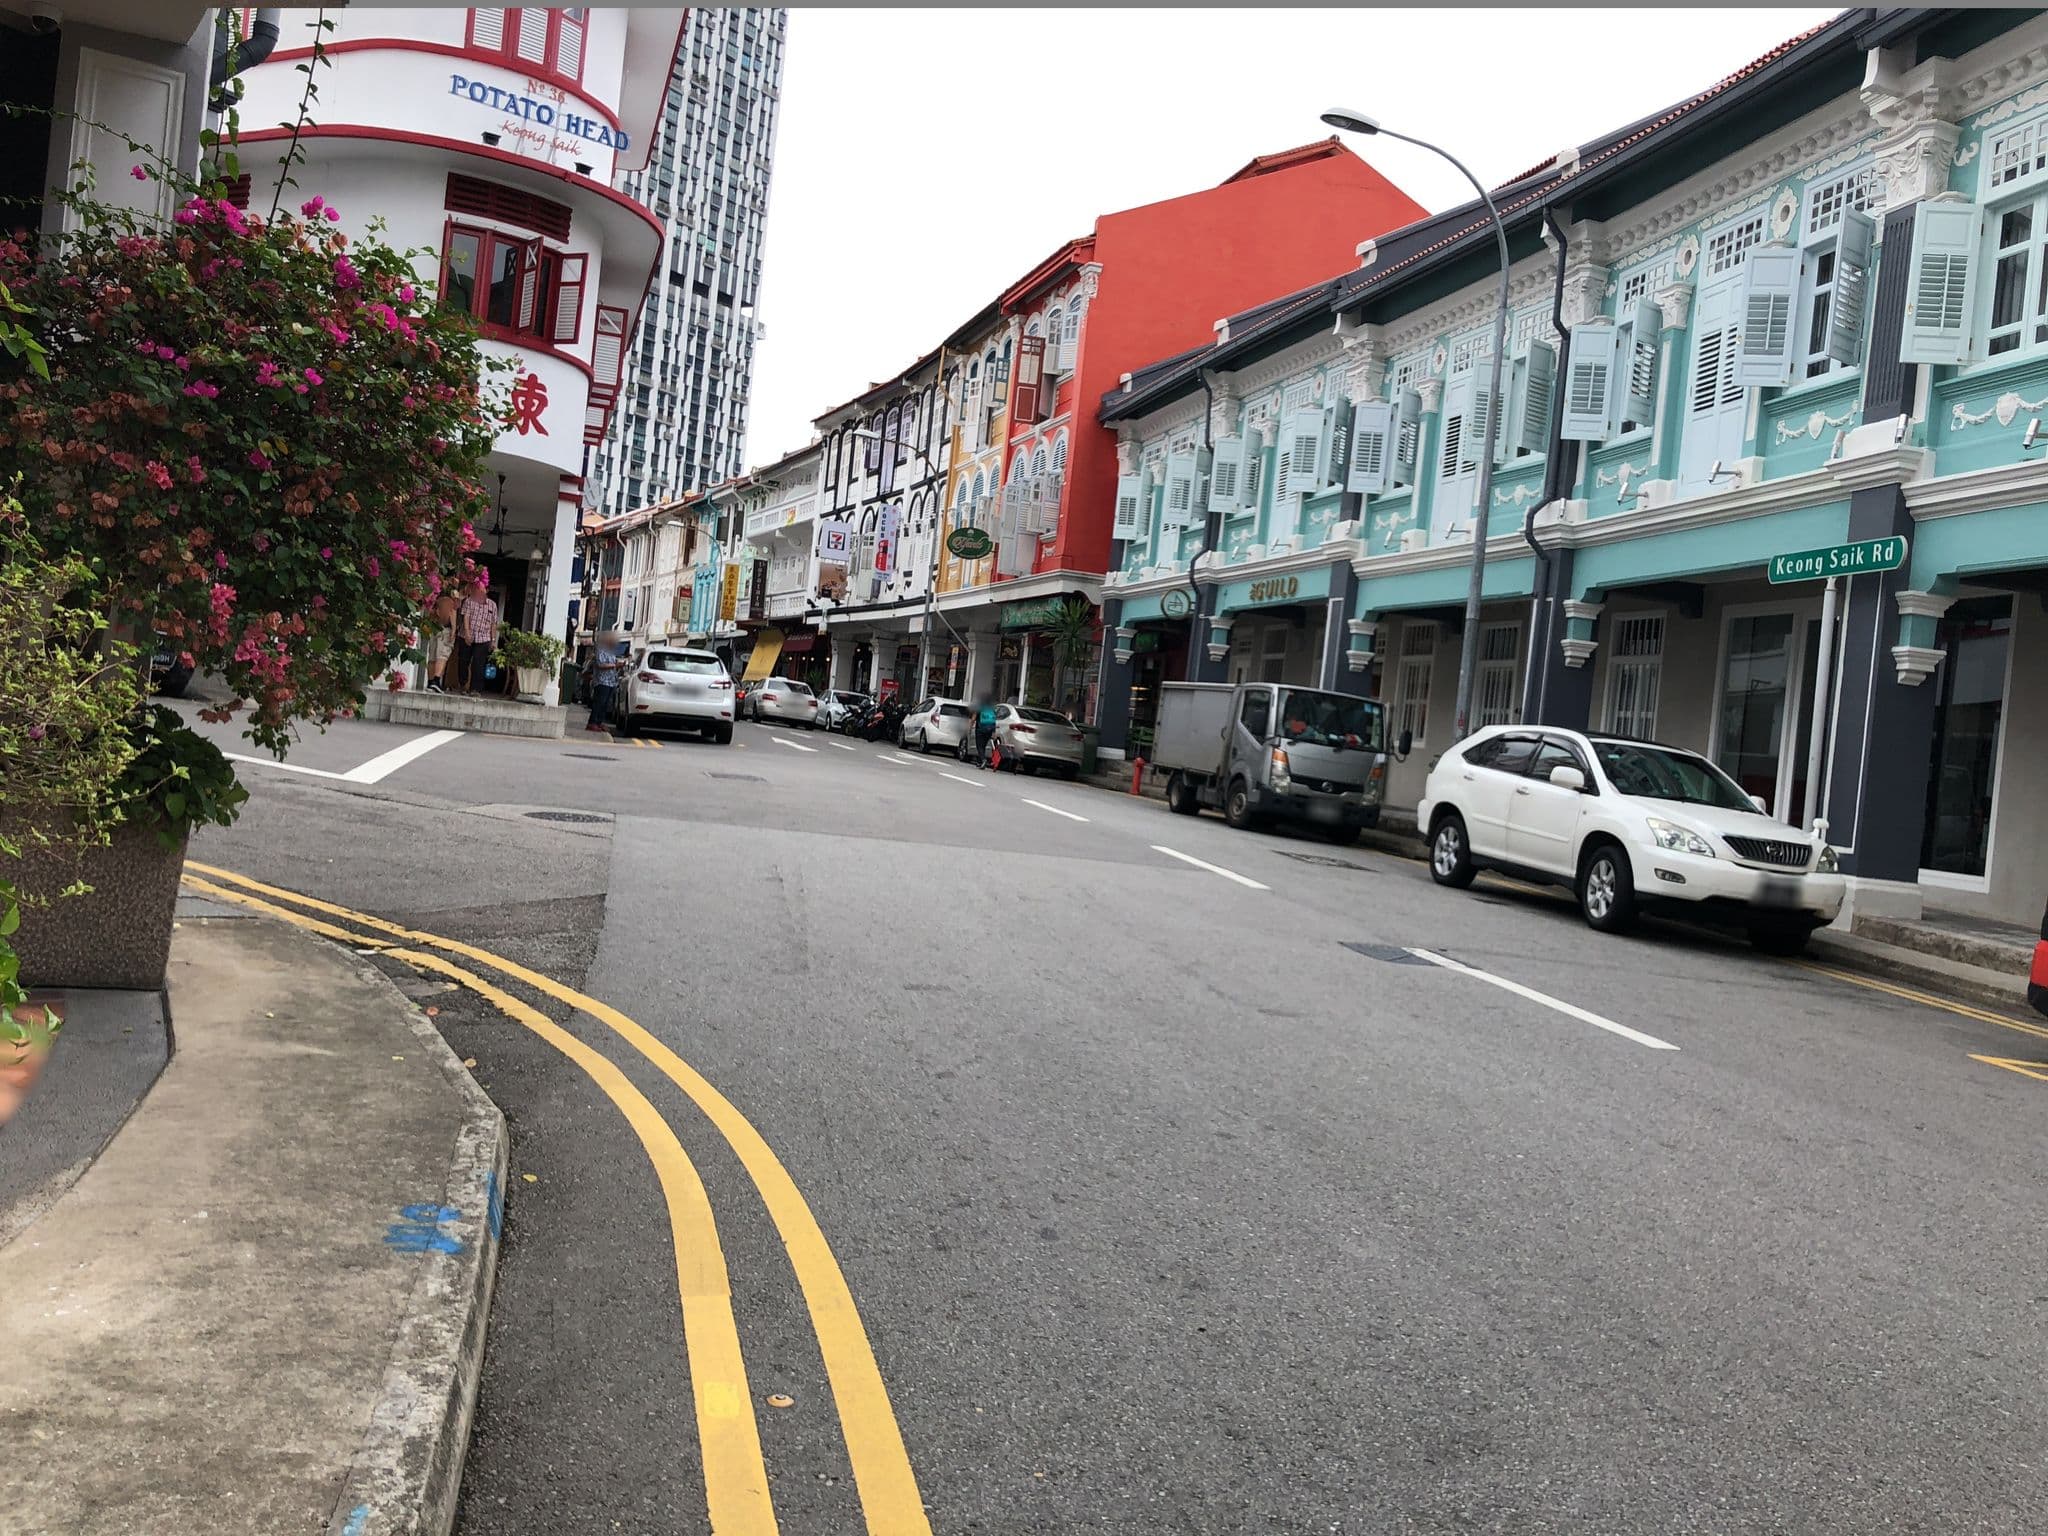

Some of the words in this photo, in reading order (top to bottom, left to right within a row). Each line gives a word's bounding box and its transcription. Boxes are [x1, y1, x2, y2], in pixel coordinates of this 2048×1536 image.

[450, 74, 554, 125] POTATO
[566, 113, 630, 151] HEAD
[548, 88, 567, 105] 36
[501, 119, 548, 151] Keong
[1776, 555, 1824, 575] Keong
[1829, 547, 1865, 568] Saik
[1872, 541, 1894, 562] Rd
[1256, 576, 1298, 601] GUILD
